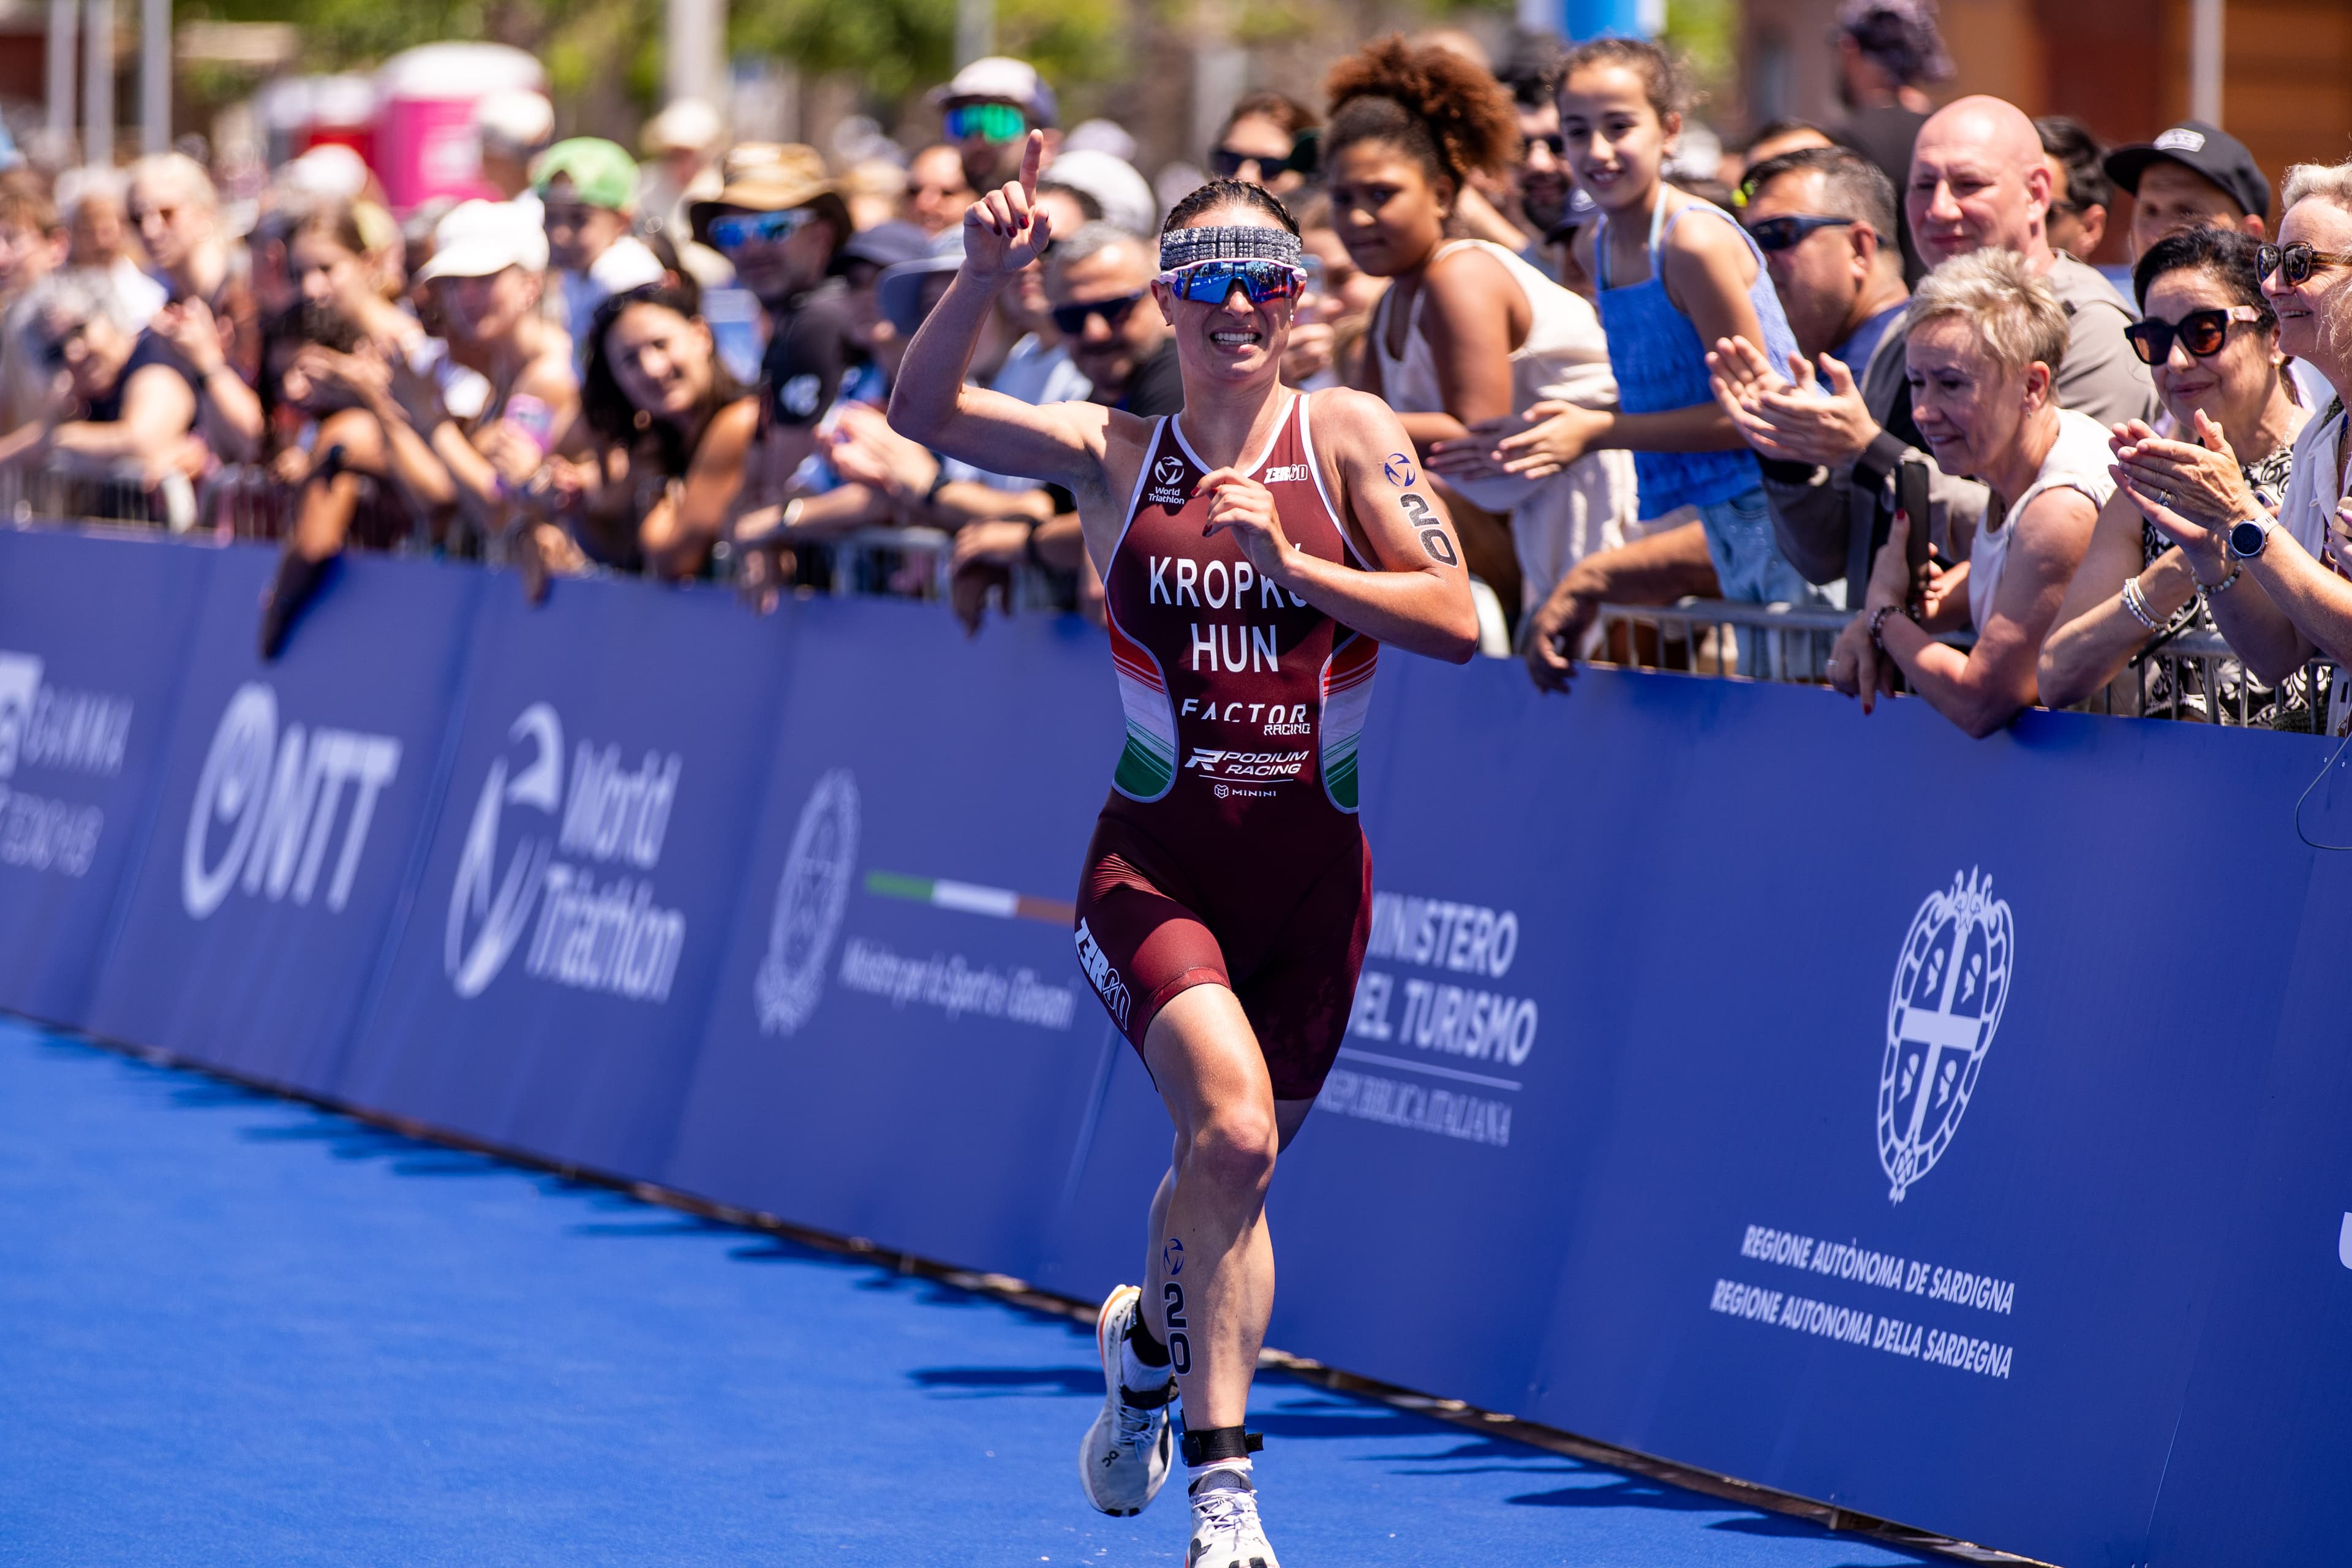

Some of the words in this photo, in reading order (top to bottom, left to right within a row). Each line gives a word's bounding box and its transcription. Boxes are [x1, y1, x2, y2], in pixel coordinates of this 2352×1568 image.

[1148, 493, 1185, 505] Triathlon
[1155, 486, 1181, 497] World
[1400, 492, 1458, 568] 20
[1150, 543, 1307, 609] KROPK
[1191, 623, 1279, 673] HUN
[1182, 698, 1306, 724] FACTOR
[1264, 723, 1311, 736] RACING
[1223, 750, 1310, 763] PODIUM
[1225, 763, 1302, 775] RACING
[242, 722, 401, 914] NTT
[559, 737, 683, 870] World
[525, 861, 686, 1006] Triathlon
[1398, 978, 1539, 1067] TURISMO
[1741, 1224, 1814, 1269] REGIONE
[1904, 1261, 1931, 1295] DE
[1928, 1265, 2015, 1315] SARDIGNA
[1164, 1281, 1192, 1376] 20
[1710, 1278, 1783, 1324] REGIONE
[1780, 1295, 1873, 1346] AUTONOMA
[1872, 1316, 1924, 1357] DELLA
[1923, 1328, 2013, 1379] SARDEGNA
